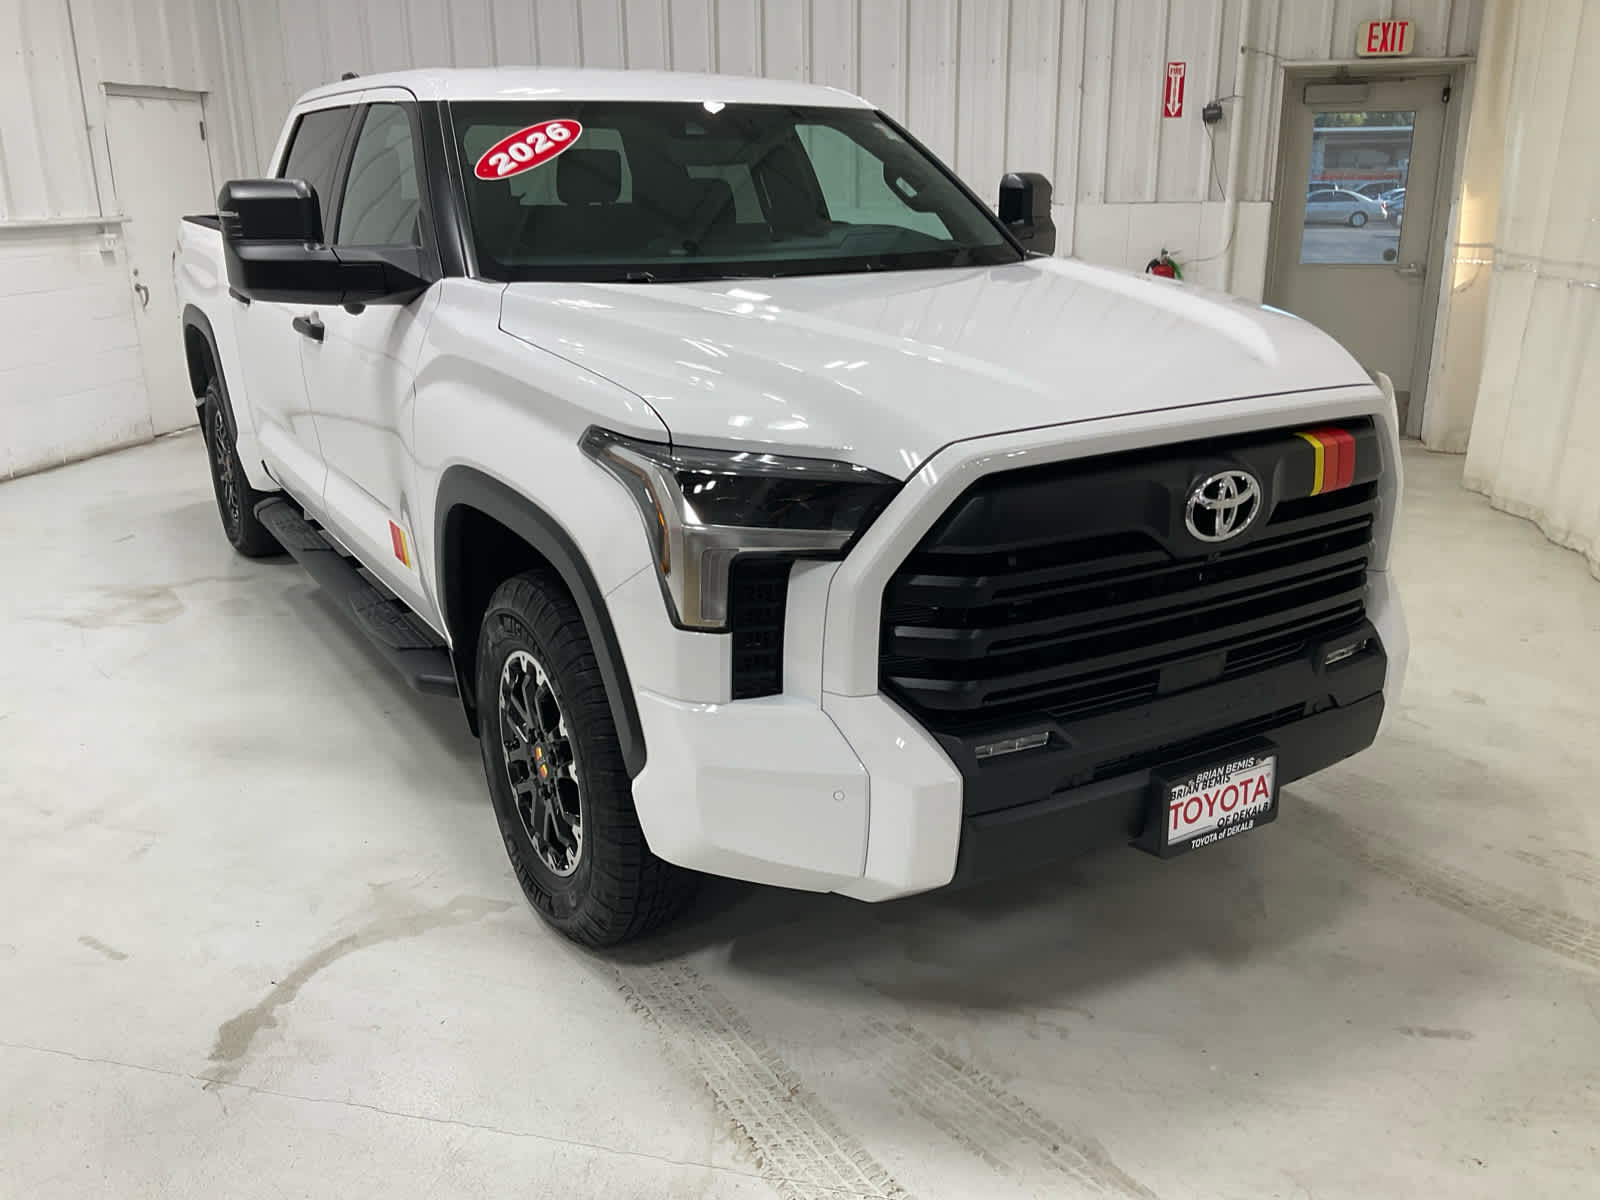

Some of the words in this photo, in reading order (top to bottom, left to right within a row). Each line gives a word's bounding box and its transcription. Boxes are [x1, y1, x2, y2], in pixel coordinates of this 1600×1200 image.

[1367, 21, 1409, 53] EXIT
[488, 123, 571, 176] 2026
[1196, 766, 1224, 784] BRIAN
[1225, 757, 1255, 774] BEMIS
[1171, 782, 1199, 800] BRIAN
[1202, 775, 1231, 790] BEMIS
[1170, 775, 1269, 830] TOYOTA
[1217, 815, 1231, 828] OF
[1232, 802, 1269, 822] DEKALB
[1191, 834, 1218, 849] TOYOTA
[1218, 829, 1226, 839] of
[1227, 820, 1254, 836] DEKALB
